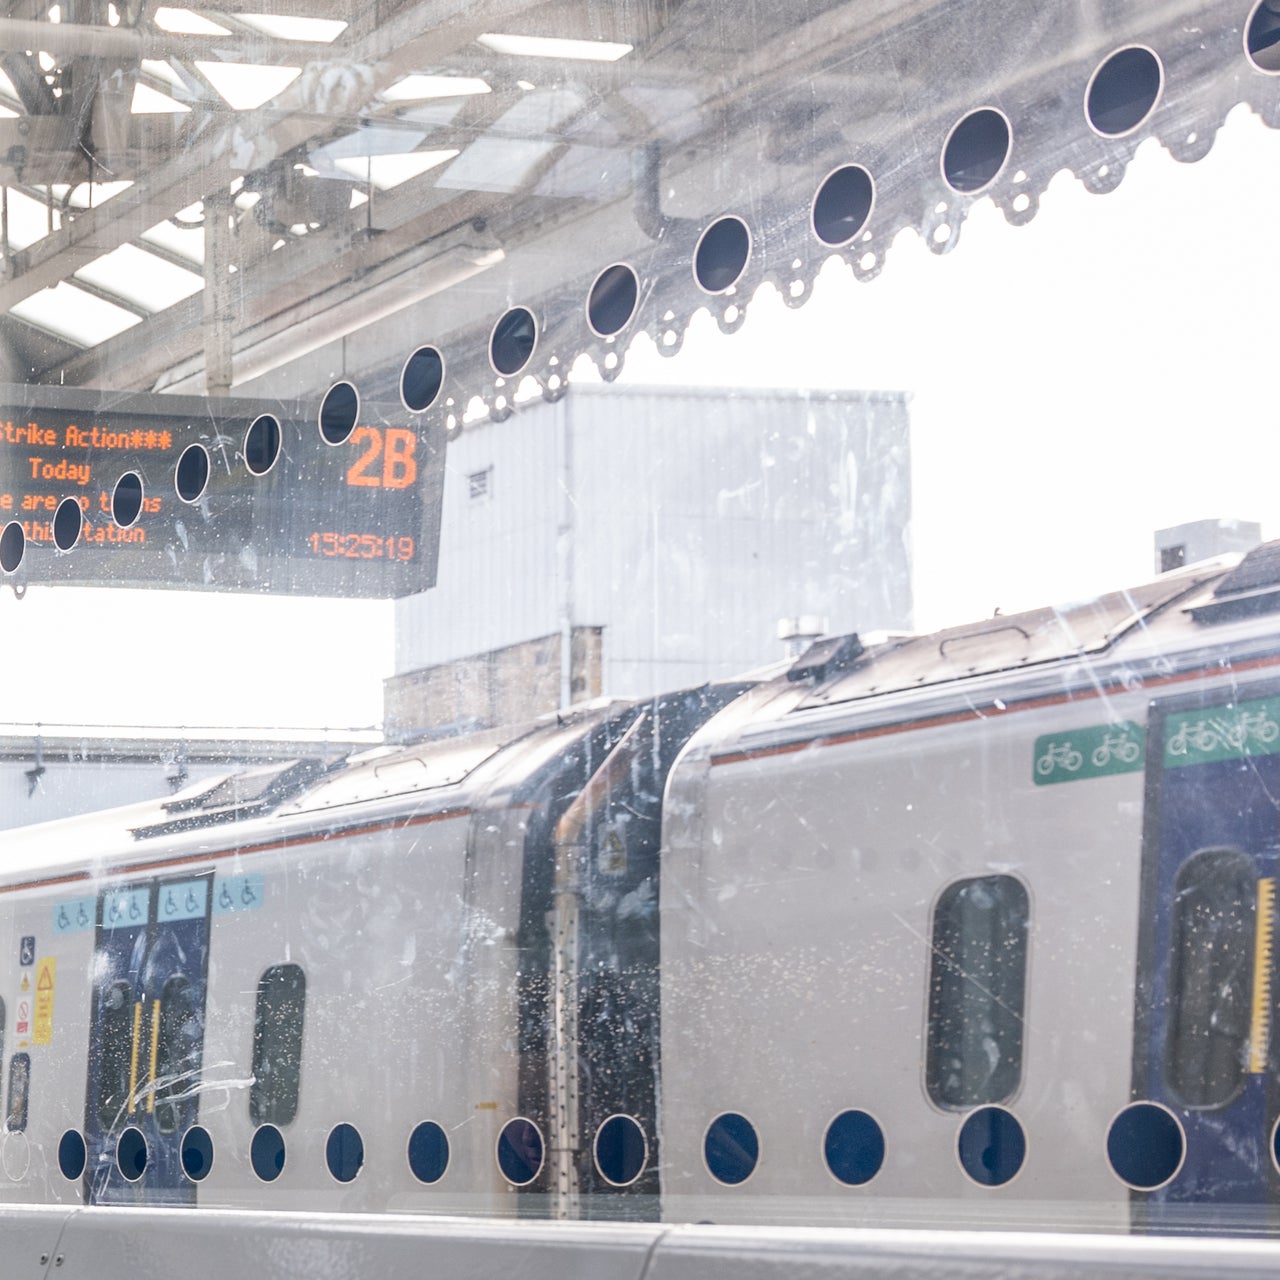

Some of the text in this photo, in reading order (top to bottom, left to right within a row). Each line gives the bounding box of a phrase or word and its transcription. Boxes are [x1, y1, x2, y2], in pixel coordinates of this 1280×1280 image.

[347, 427, 416, 488] 2B
[29, 457, 91, 485] Today
[21, 495, 57, 510] are
[23, 521, 53, 541] thi
[82, 523, 145, 542] tation
[311, 533, 413, 559] 15:25:19
